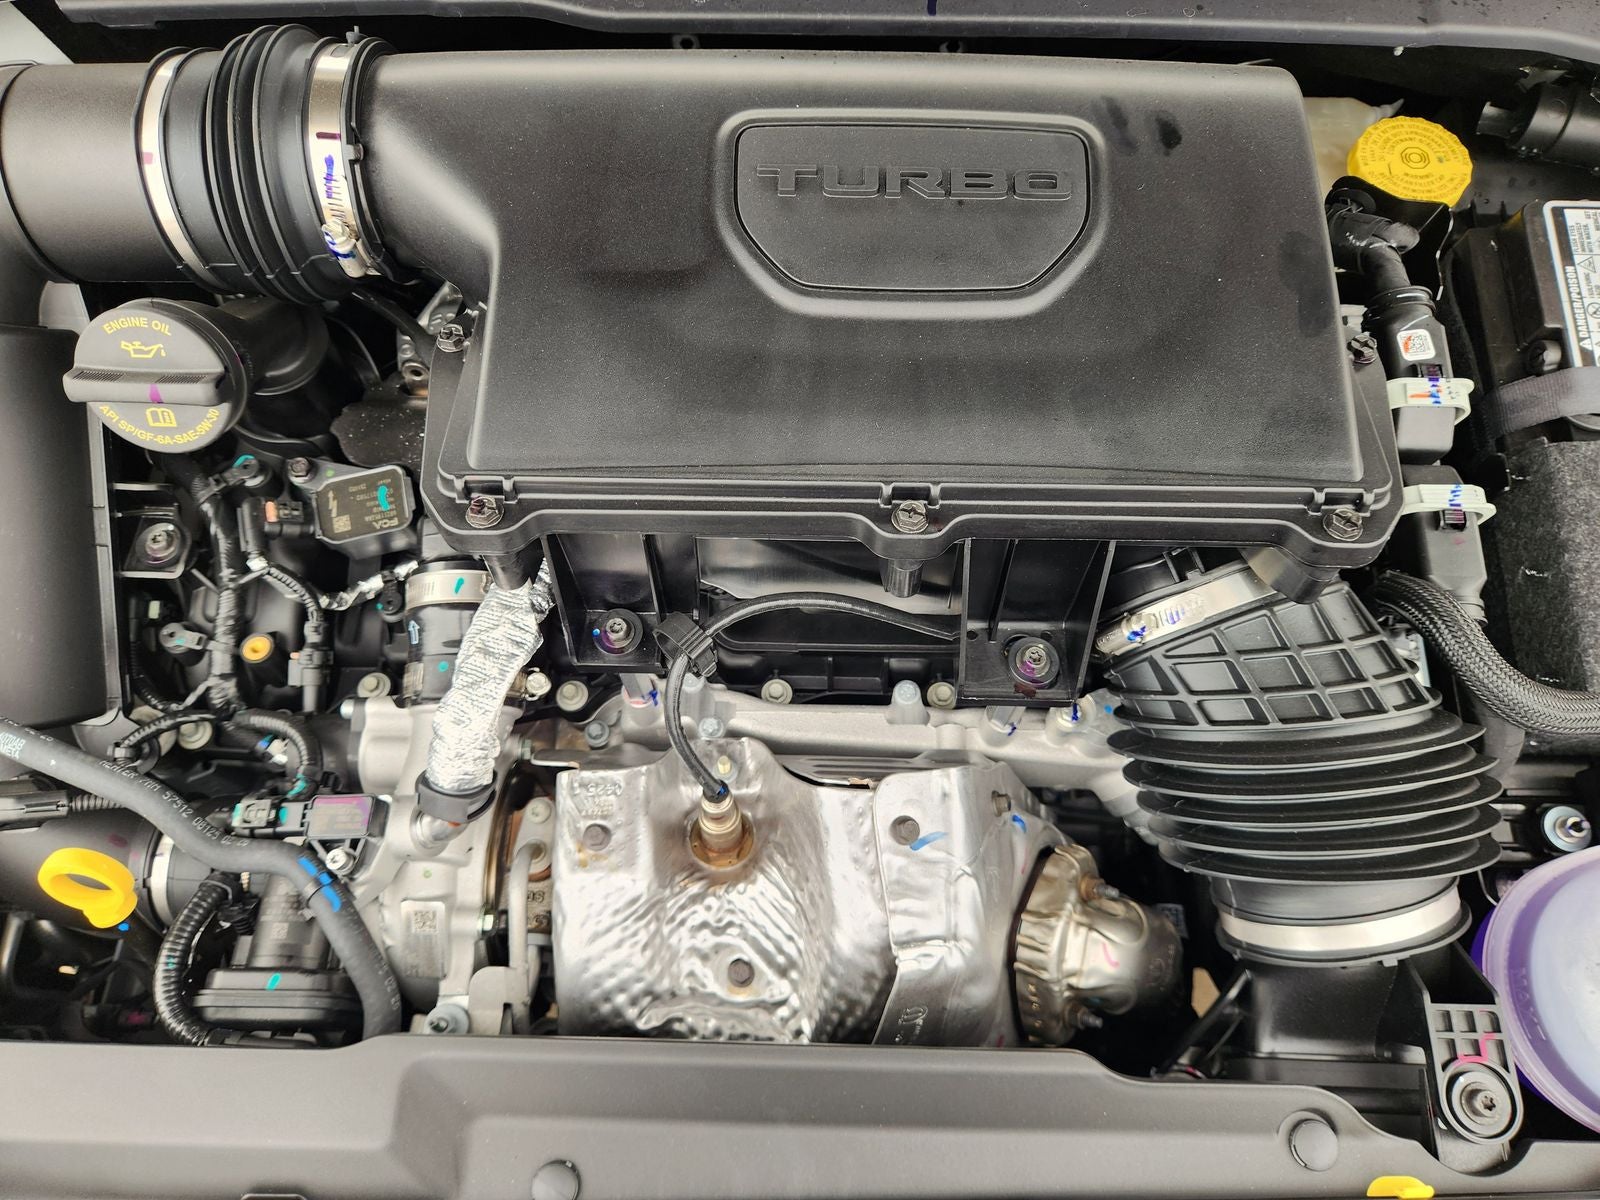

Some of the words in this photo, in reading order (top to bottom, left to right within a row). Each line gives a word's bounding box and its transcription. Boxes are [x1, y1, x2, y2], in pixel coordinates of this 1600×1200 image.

[756, 162, 1073, 201] TURBO
[1564, 266, 1590, 338] DANGER/POISON
[102, 316, 149, 335] ENGINE
[151, 319, 173, 337] OIL
[99, 404, 119, 423] API
